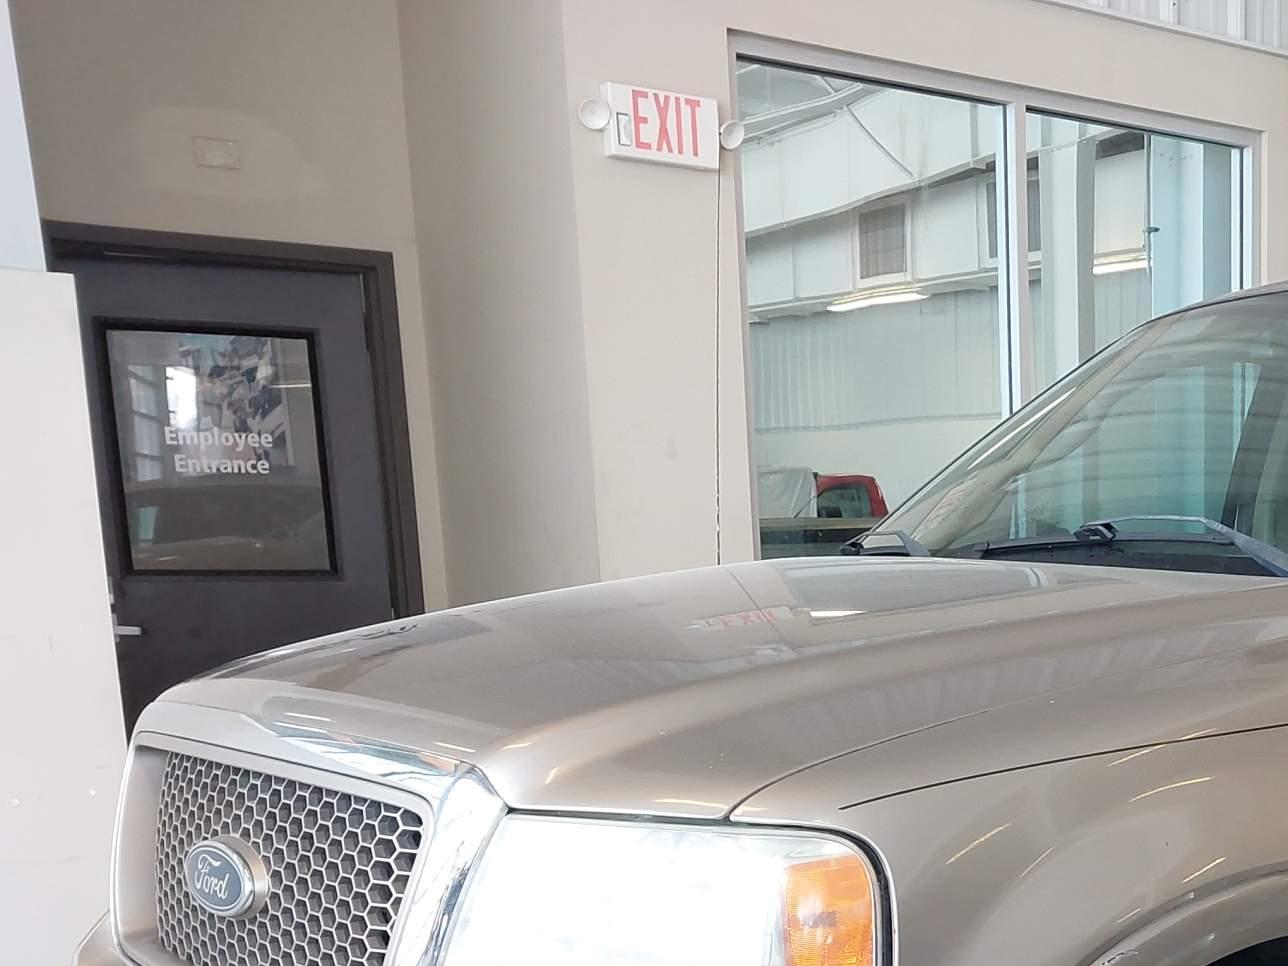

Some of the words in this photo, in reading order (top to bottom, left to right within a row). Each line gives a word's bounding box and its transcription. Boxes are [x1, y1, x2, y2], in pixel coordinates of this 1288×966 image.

[631, 89, 701, 158] EXIT
[164, 426, 273, 452] Employee
[174, 454, 270, 474] Entrance
[195, 854, 229, 899] Ford
